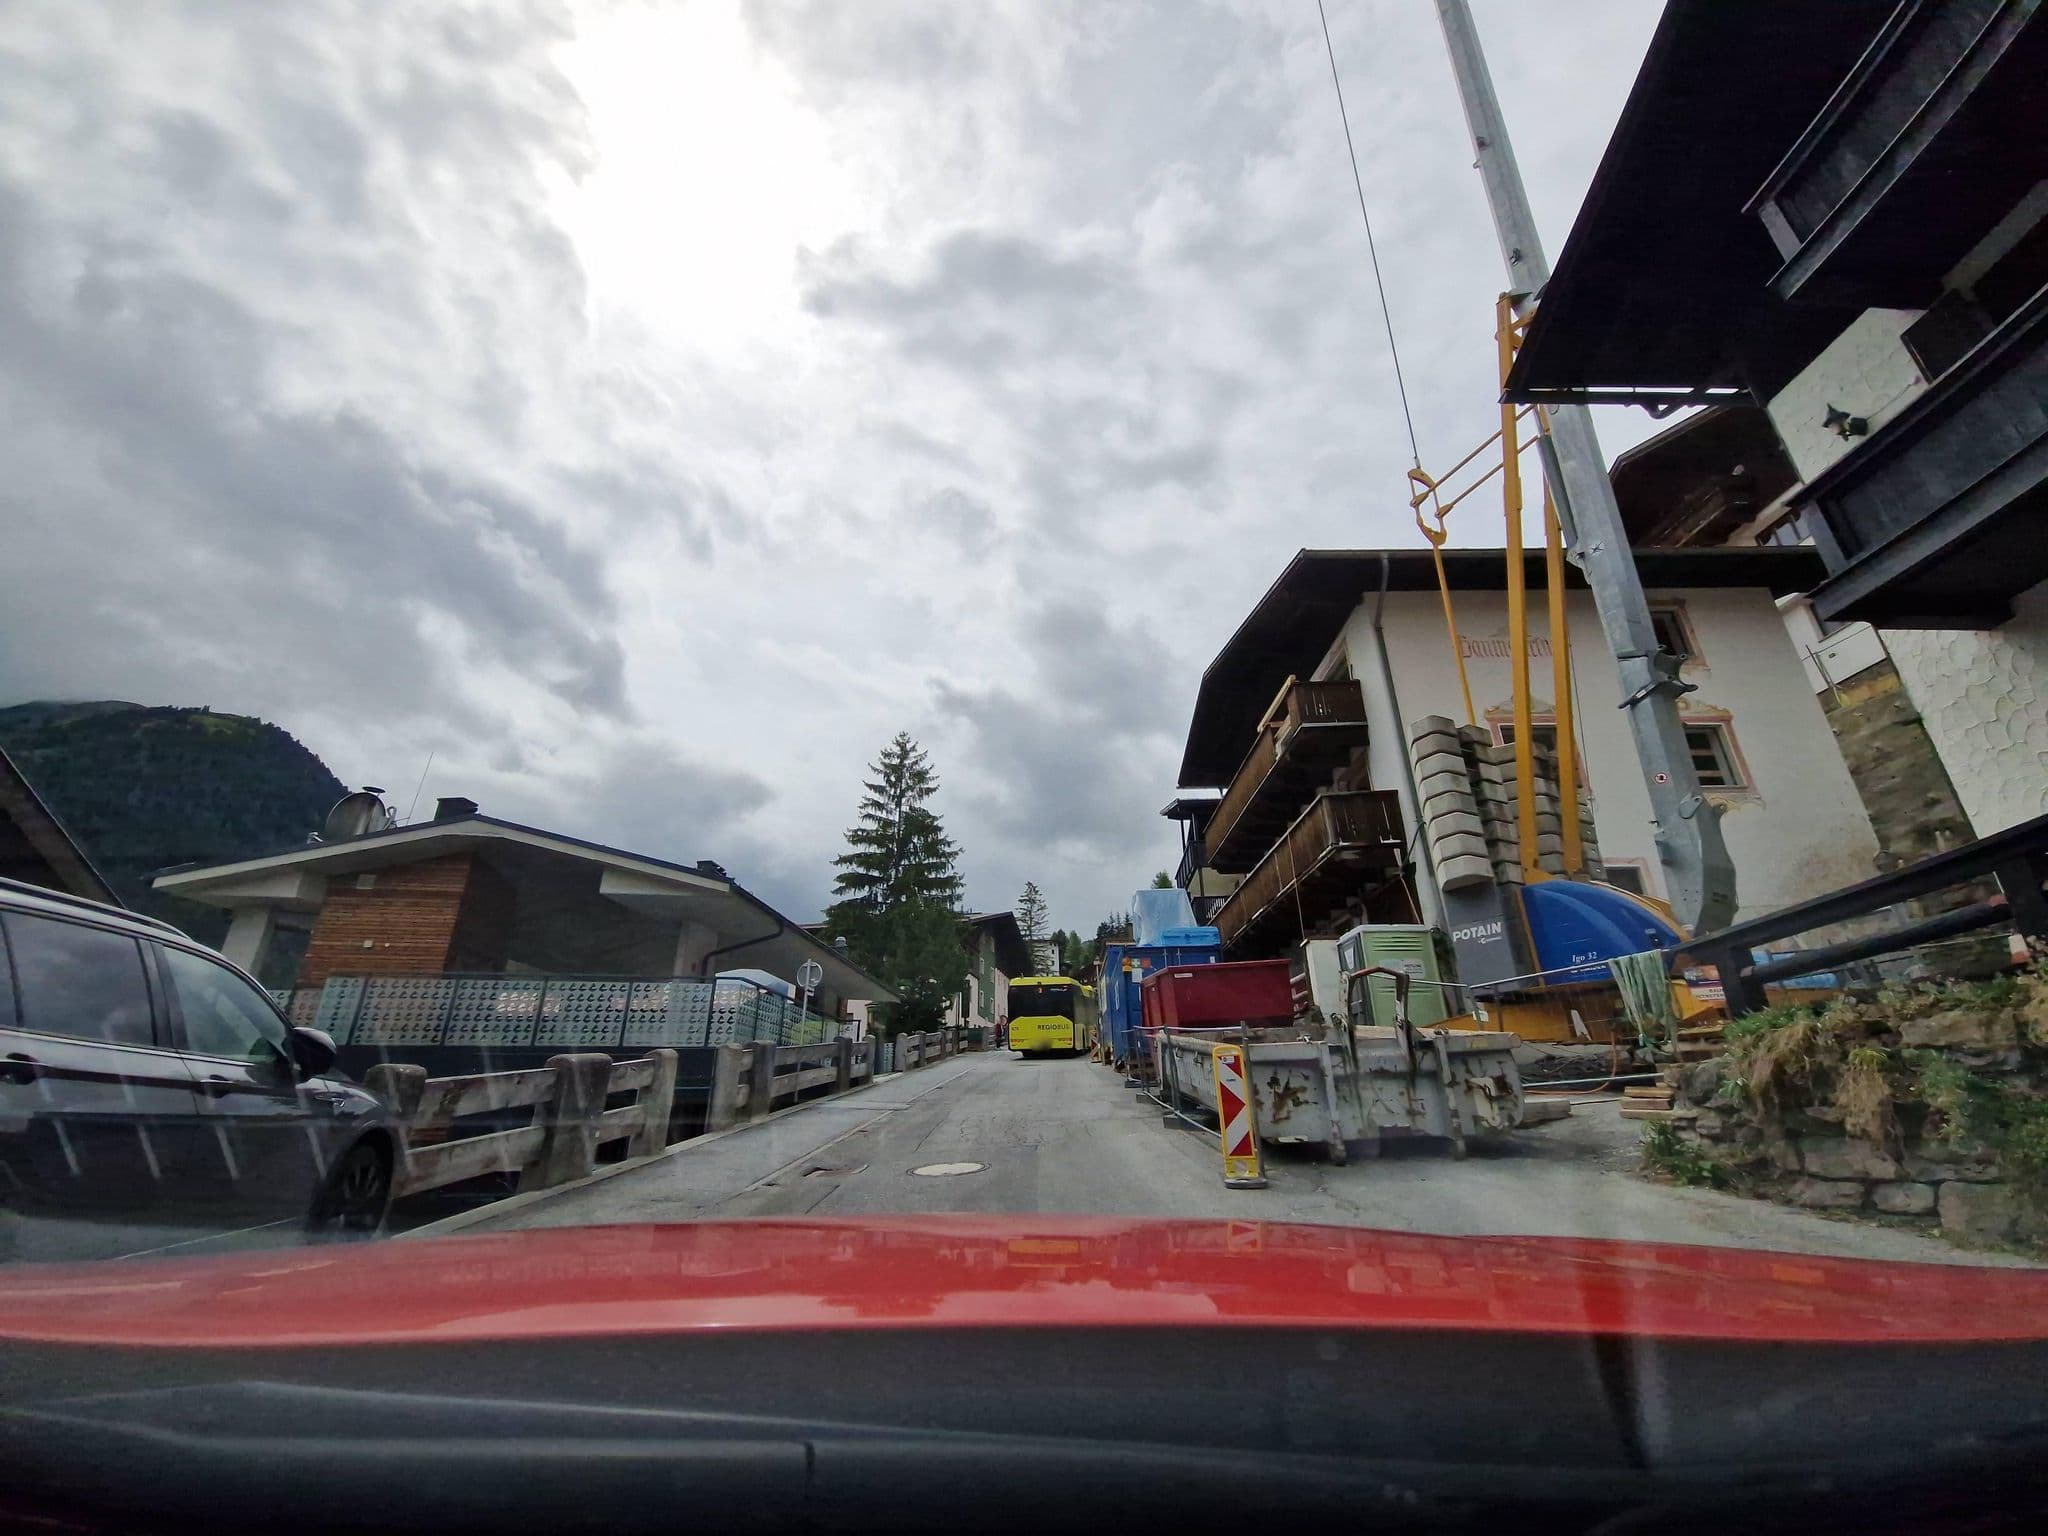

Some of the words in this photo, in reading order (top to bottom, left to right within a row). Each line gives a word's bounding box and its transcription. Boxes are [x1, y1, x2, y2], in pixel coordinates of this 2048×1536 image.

[1453, 921, 1501, 942] POTAIN
[1587, 951, 1598, 960] 32
[1037, 1023, 1070, 1031] REGIOBUS
